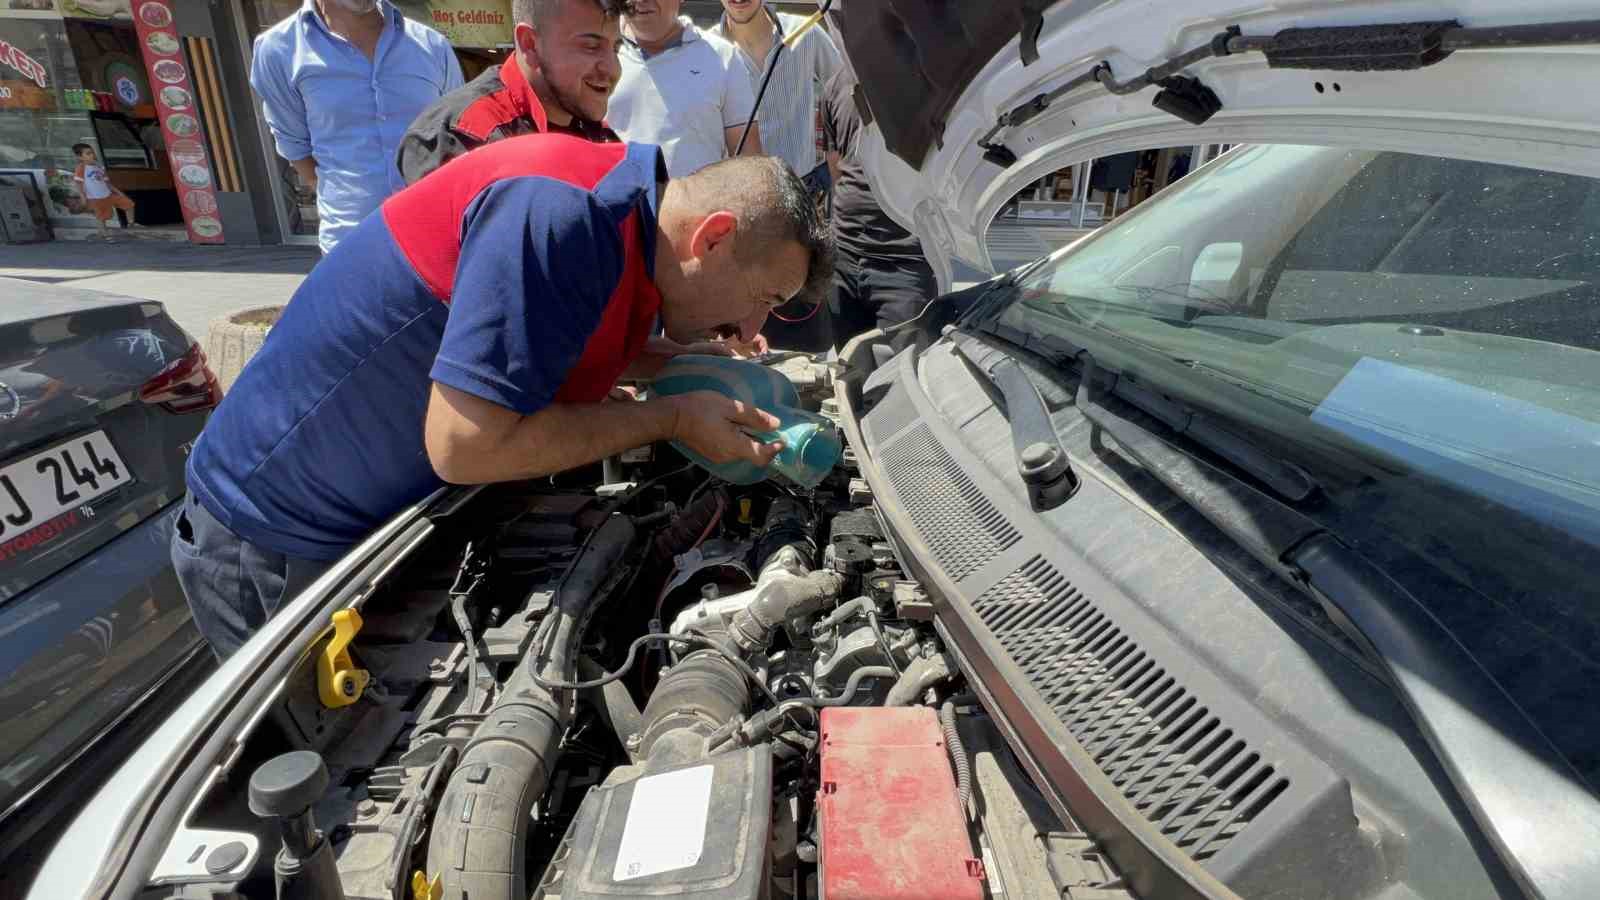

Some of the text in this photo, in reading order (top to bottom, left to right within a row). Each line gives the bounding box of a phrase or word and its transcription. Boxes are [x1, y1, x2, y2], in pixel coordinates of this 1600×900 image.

[432, 10, 505, 26] Hoş Geldiniz
[36, 440, 120, 506] 244
